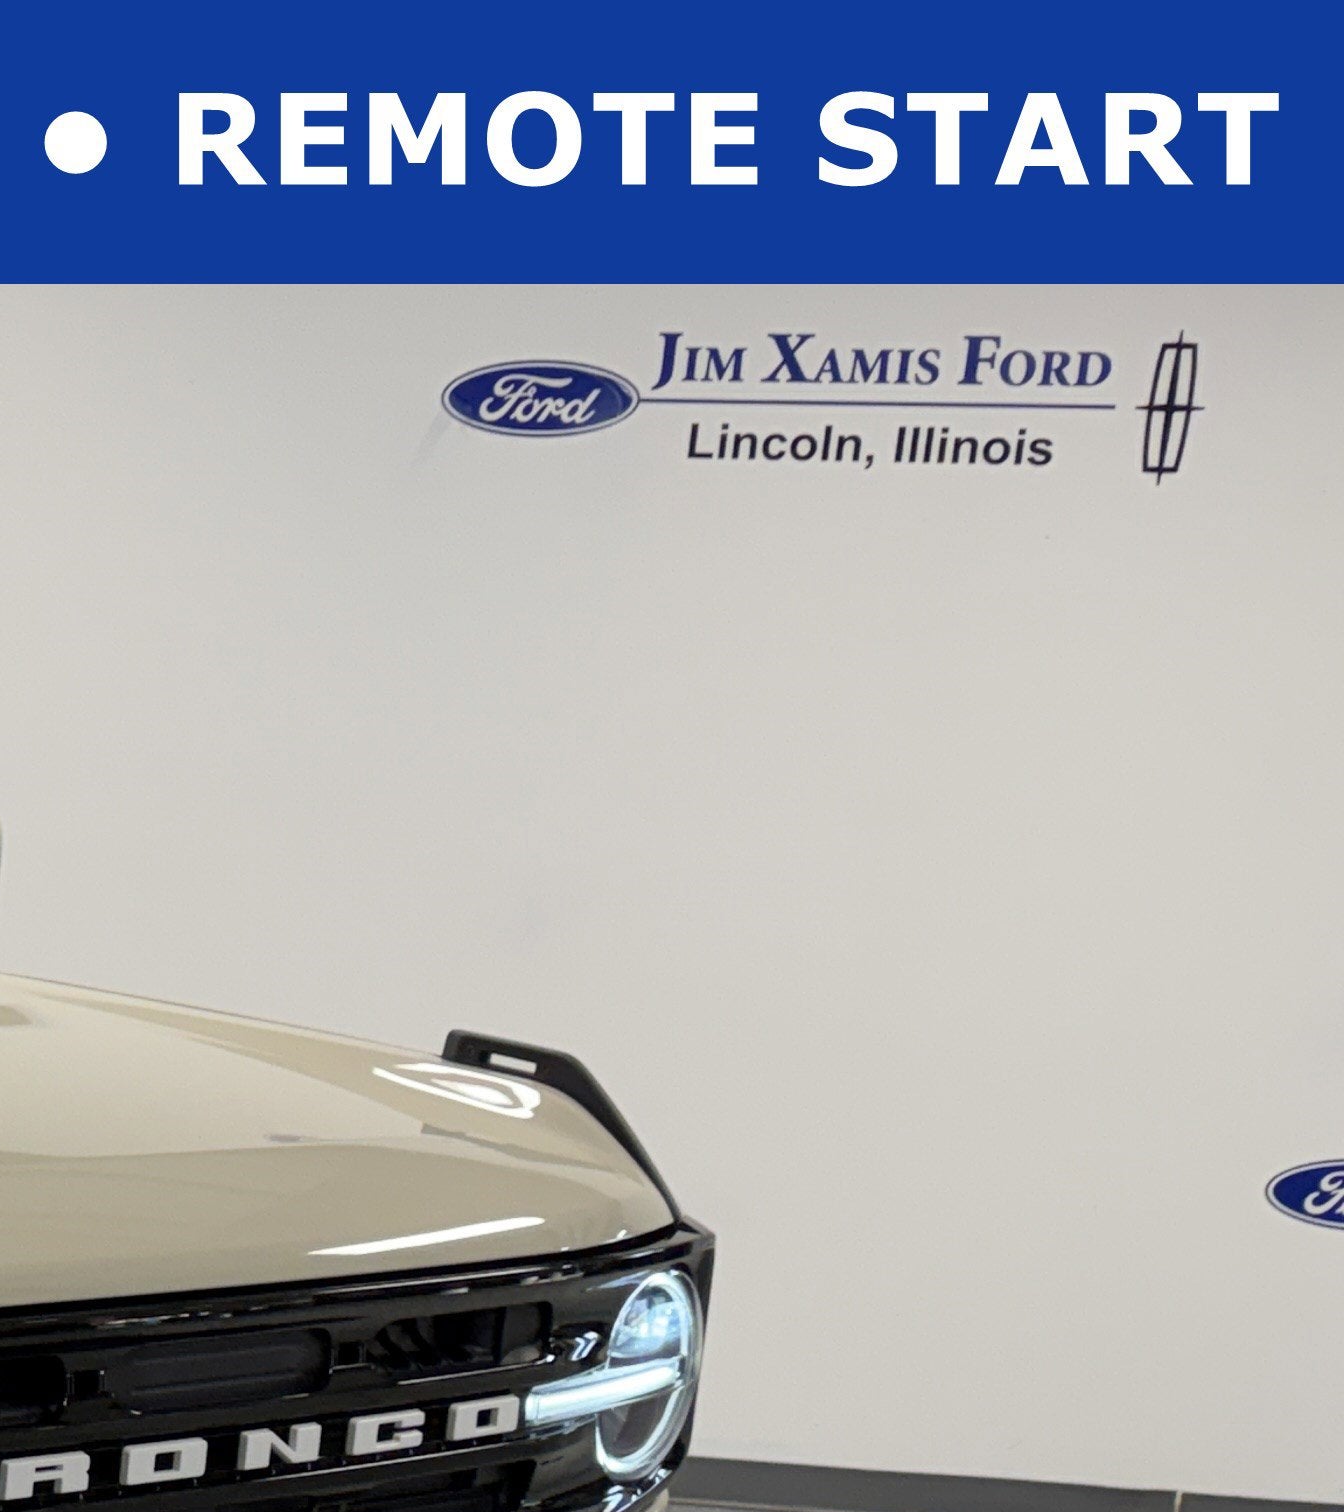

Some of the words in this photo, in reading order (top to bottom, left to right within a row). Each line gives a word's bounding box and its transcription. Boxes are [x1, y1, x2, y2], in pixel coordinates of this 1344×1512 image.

[651, 332, 747, 391] JIM
[760, 333, 941, 387] XAMIS
[957, 335, 1112, 388] FORD
[478, 375, 597, 427] Ford
[687, 423, 874, 470] Lincoln,
[893, 426, 1054, 467] Illinois
